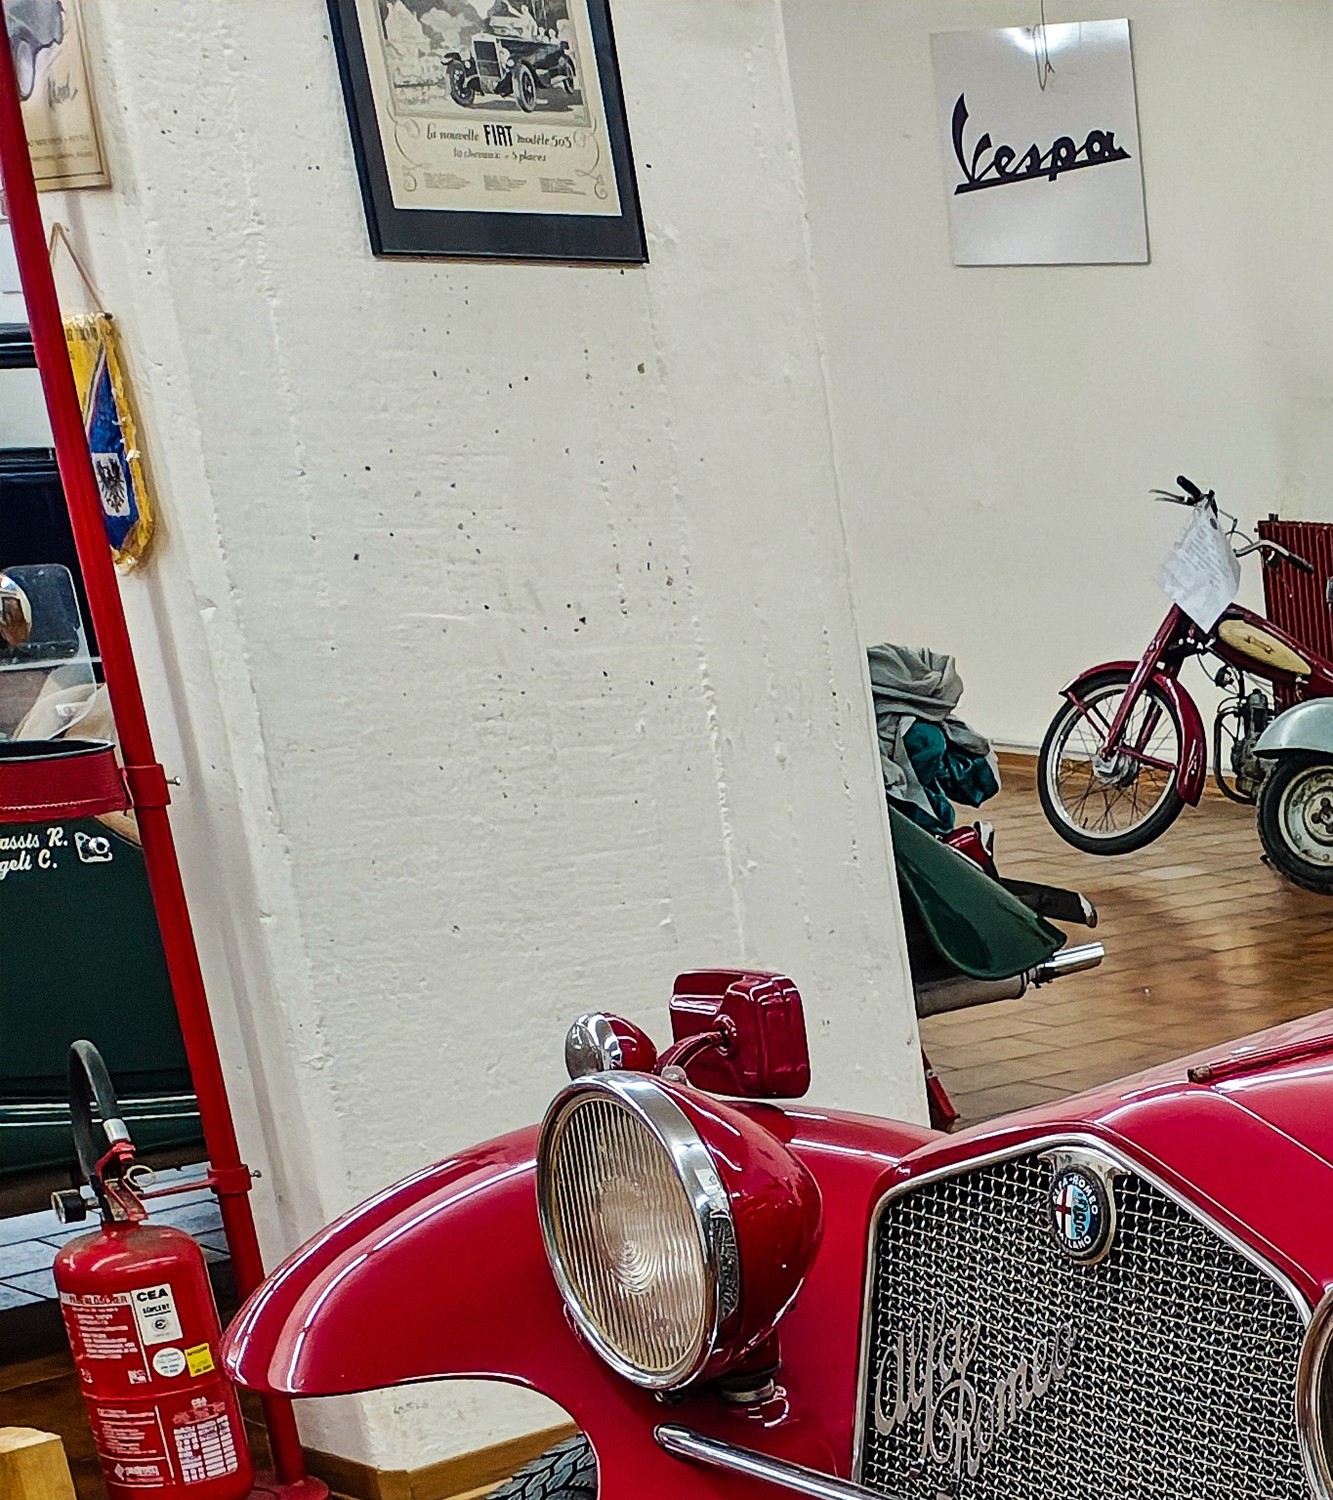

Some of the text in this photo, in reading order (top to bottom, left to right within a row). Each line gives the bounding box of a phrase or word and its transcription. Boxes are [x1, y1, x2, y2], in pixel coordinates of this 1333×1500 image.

[483, 124, 513, 147] FIAT
[952, 92, 1132, 195] Vespa
[46, 826, 68, 847] R.
[37, 848, 58, 869] C.
[1057, 1229, 1092, 1250] MILANO
[136, 1288, 169, 1302] CEA
